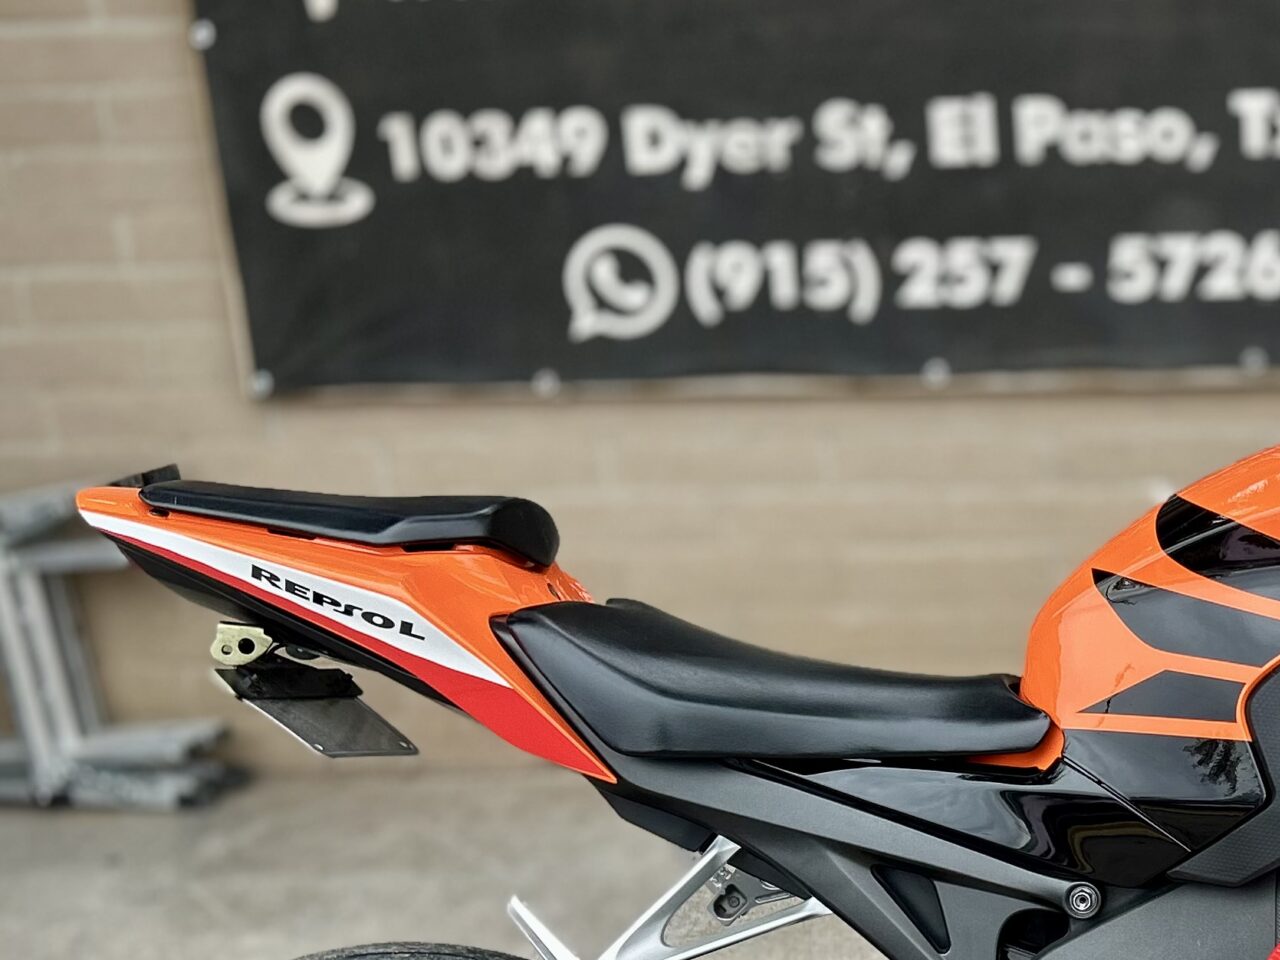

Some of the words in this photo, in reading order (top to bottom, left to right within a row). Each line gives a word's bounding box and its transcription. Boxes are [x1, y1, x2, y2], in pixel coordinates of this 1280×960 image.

[379, 106, 608, 183] 10349
[621, 104, 803, 192] Dyer
[813, 97, 915, 178] St,
[925, 91, 1000, 169] El
[1011, 94, 1219, 171] Paso,
[684, 239, 883, 326] (915)
[892, 235, 1037, 309] 257
[1051, 261, 1093, 293] -
[250, 564, 426, 641] REPSOL
